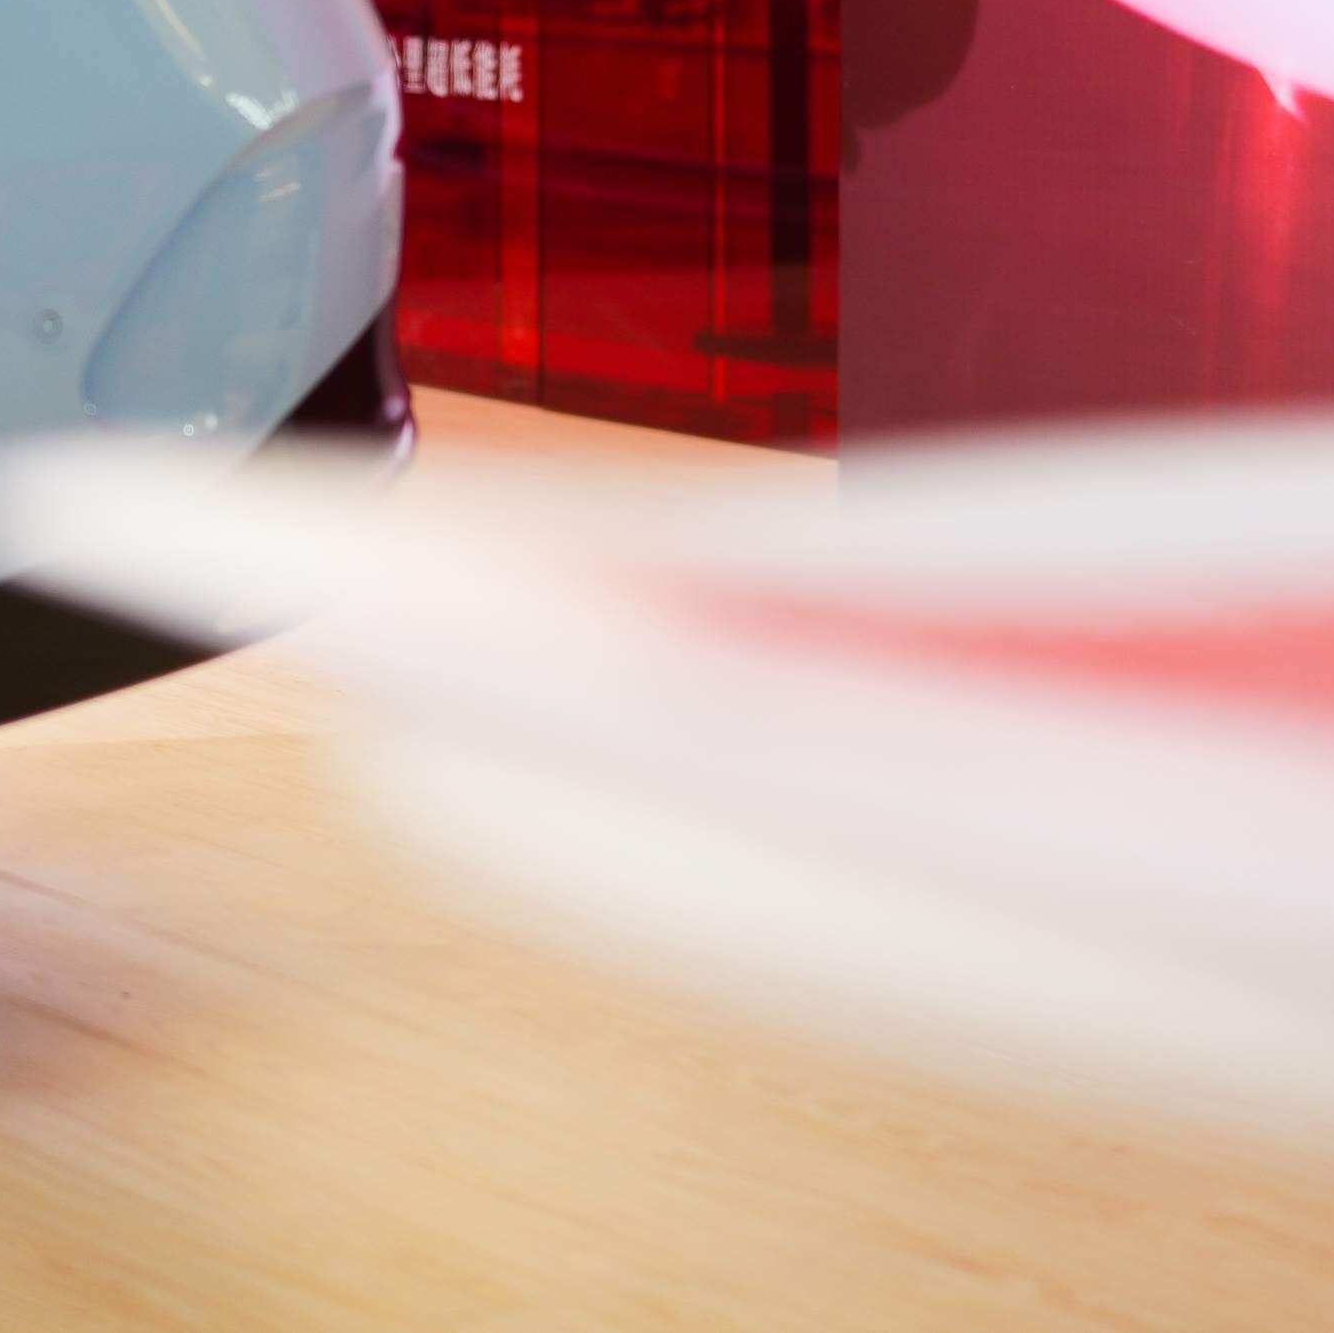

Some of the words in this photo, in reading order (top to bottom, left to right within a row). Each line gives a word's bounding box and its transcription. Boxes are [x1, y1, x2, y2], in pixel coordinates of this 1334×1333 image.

[390, 34, 524, 103] 里超低能耗
